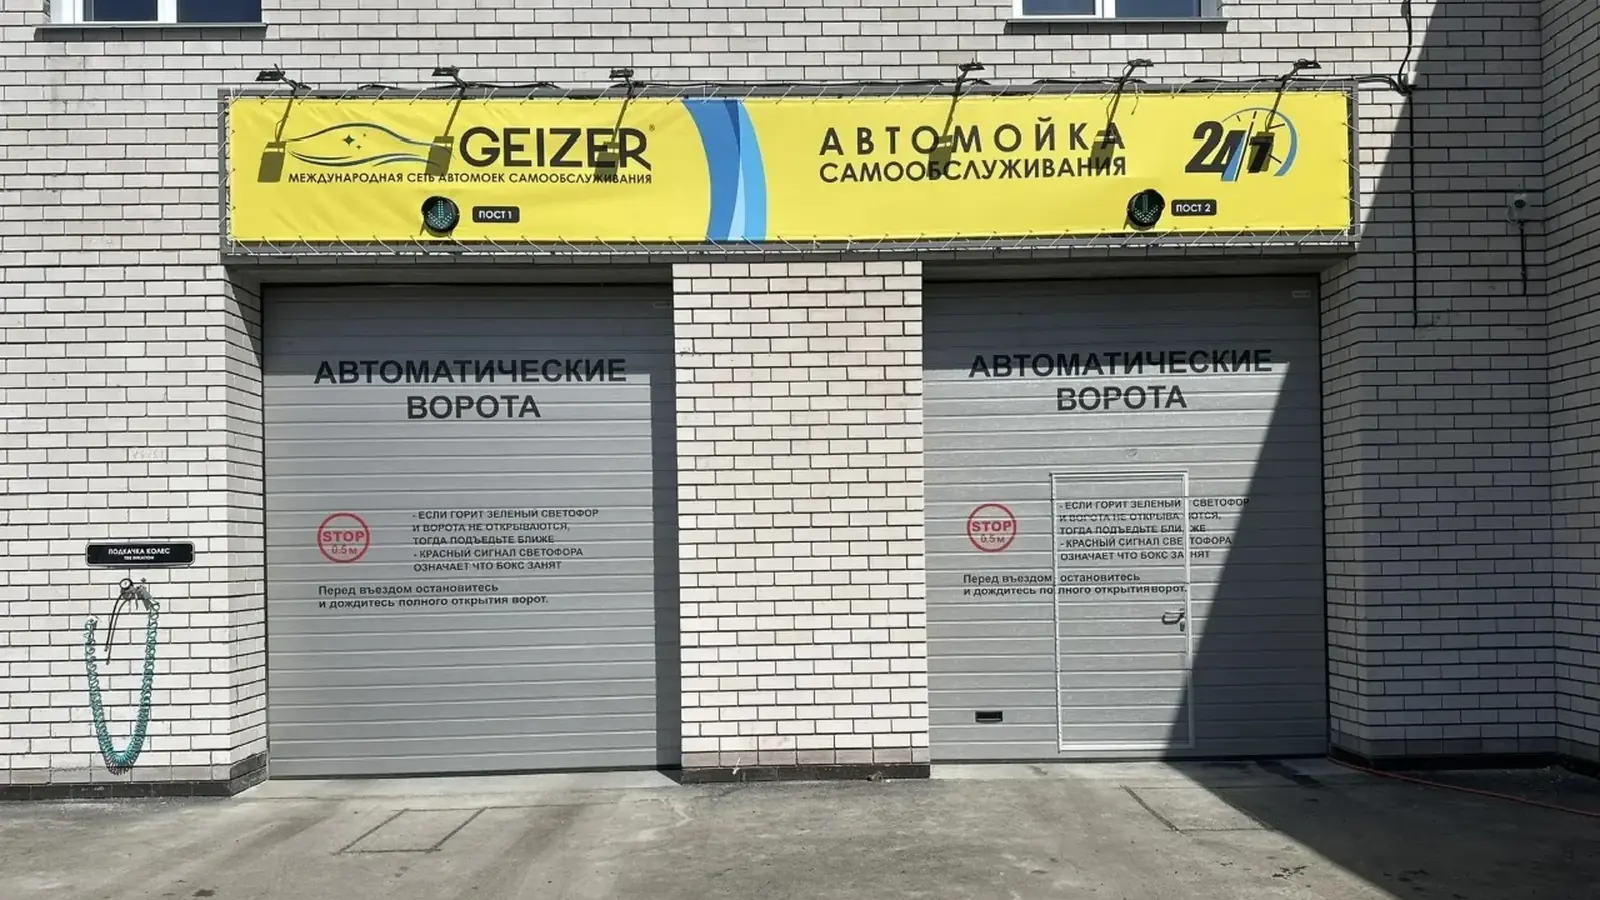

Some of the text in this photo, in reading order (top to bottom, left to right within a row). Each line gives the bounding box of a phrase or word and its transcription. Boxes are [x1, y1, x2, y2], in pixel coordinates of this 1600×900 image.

[819, 117, 1126, 156] АВТОМОЙКА
[459, 126, 652, 171] GEIZER
[819, 157, 1126, 184] САМООБСЛУЖИВАНИЯ
[288, 172, 653, 185] МЕЖДУНАРОДНАЯ СЕТЬ АВТОМОЕК САМООБСЛУЖИВАНИЯ
[478, 209, 512, 219] ПОСТ 1
[1175, 203, 1211, 213] ПОСТ 2
[968, 349, 1272, 378] АВТОМАТИЧЕСКИЕ
[314, 358, 627, 384] АВТОМАТИЧЕСКИЕ
[1057, 385, 1187, 411] ВОРОТА
[407, 395, 541, 419] ВОРОТА
[1065, 501, 1092, 509] ЕСЛИ
[1095, 500, 1127, 509] ГОРИТ
[1192, 498, 1250, 507] СВЕТОФОР
[418, 510, 447, 519] ЕСЛИ
[450, 510, 483, 519] ГОРИТ
[487, 508, 539, 518] ЗЕЛЕНЫЙ
[543, 509, 599, 518] СВЕТОФОР
[412, 522, 571, 532] И ВОРОТА НЕ ОТКРЫВАЮТСЯ,
[972, 520, 1012, 532] STOP
[1060, 526, 1092, 535] ТОГДА
[1095, 525, 1157, 535] ПОДЪЕДЬТЕ
[322, 531, 365, 542] STOP
[413, 535, 554, 545] ТОГДА ПОДЪЕДЬТЕ БЛИЖЕ
[1066, 537, 1116, 548] КРАСНЫЙ
[1118, 537, 1159, 546] СИГНАЛ
[1162, 536, 1232, 546] СВЕТОФОРА
[420, 548, 471, 558] КРАСНЫЙ
[474, 548, 516, 558] СИГНАЛ
[519, 548, 583, 557] СВЕТОФОРА
[1060, 550, 1210, 561] ОЗНАЧАЕТ ЧТО БОКС ЗАНЯТ
[413, 560, 562, 572] ОЗНАЧАЕТ ЧТО БОКС ЗАНЯТ
[963, 573, 1141, 585] Перед въездом остановитесь
[318, 583, 499, 597] Перед въездом остановитесь
[963, 588, 970, 596] и
[973, 587, 1036, 597] дождитесь
[1039, 586, 1091, 594] полного
[318, 595, 548, 609] и дождитесь полного открытия ворот.
